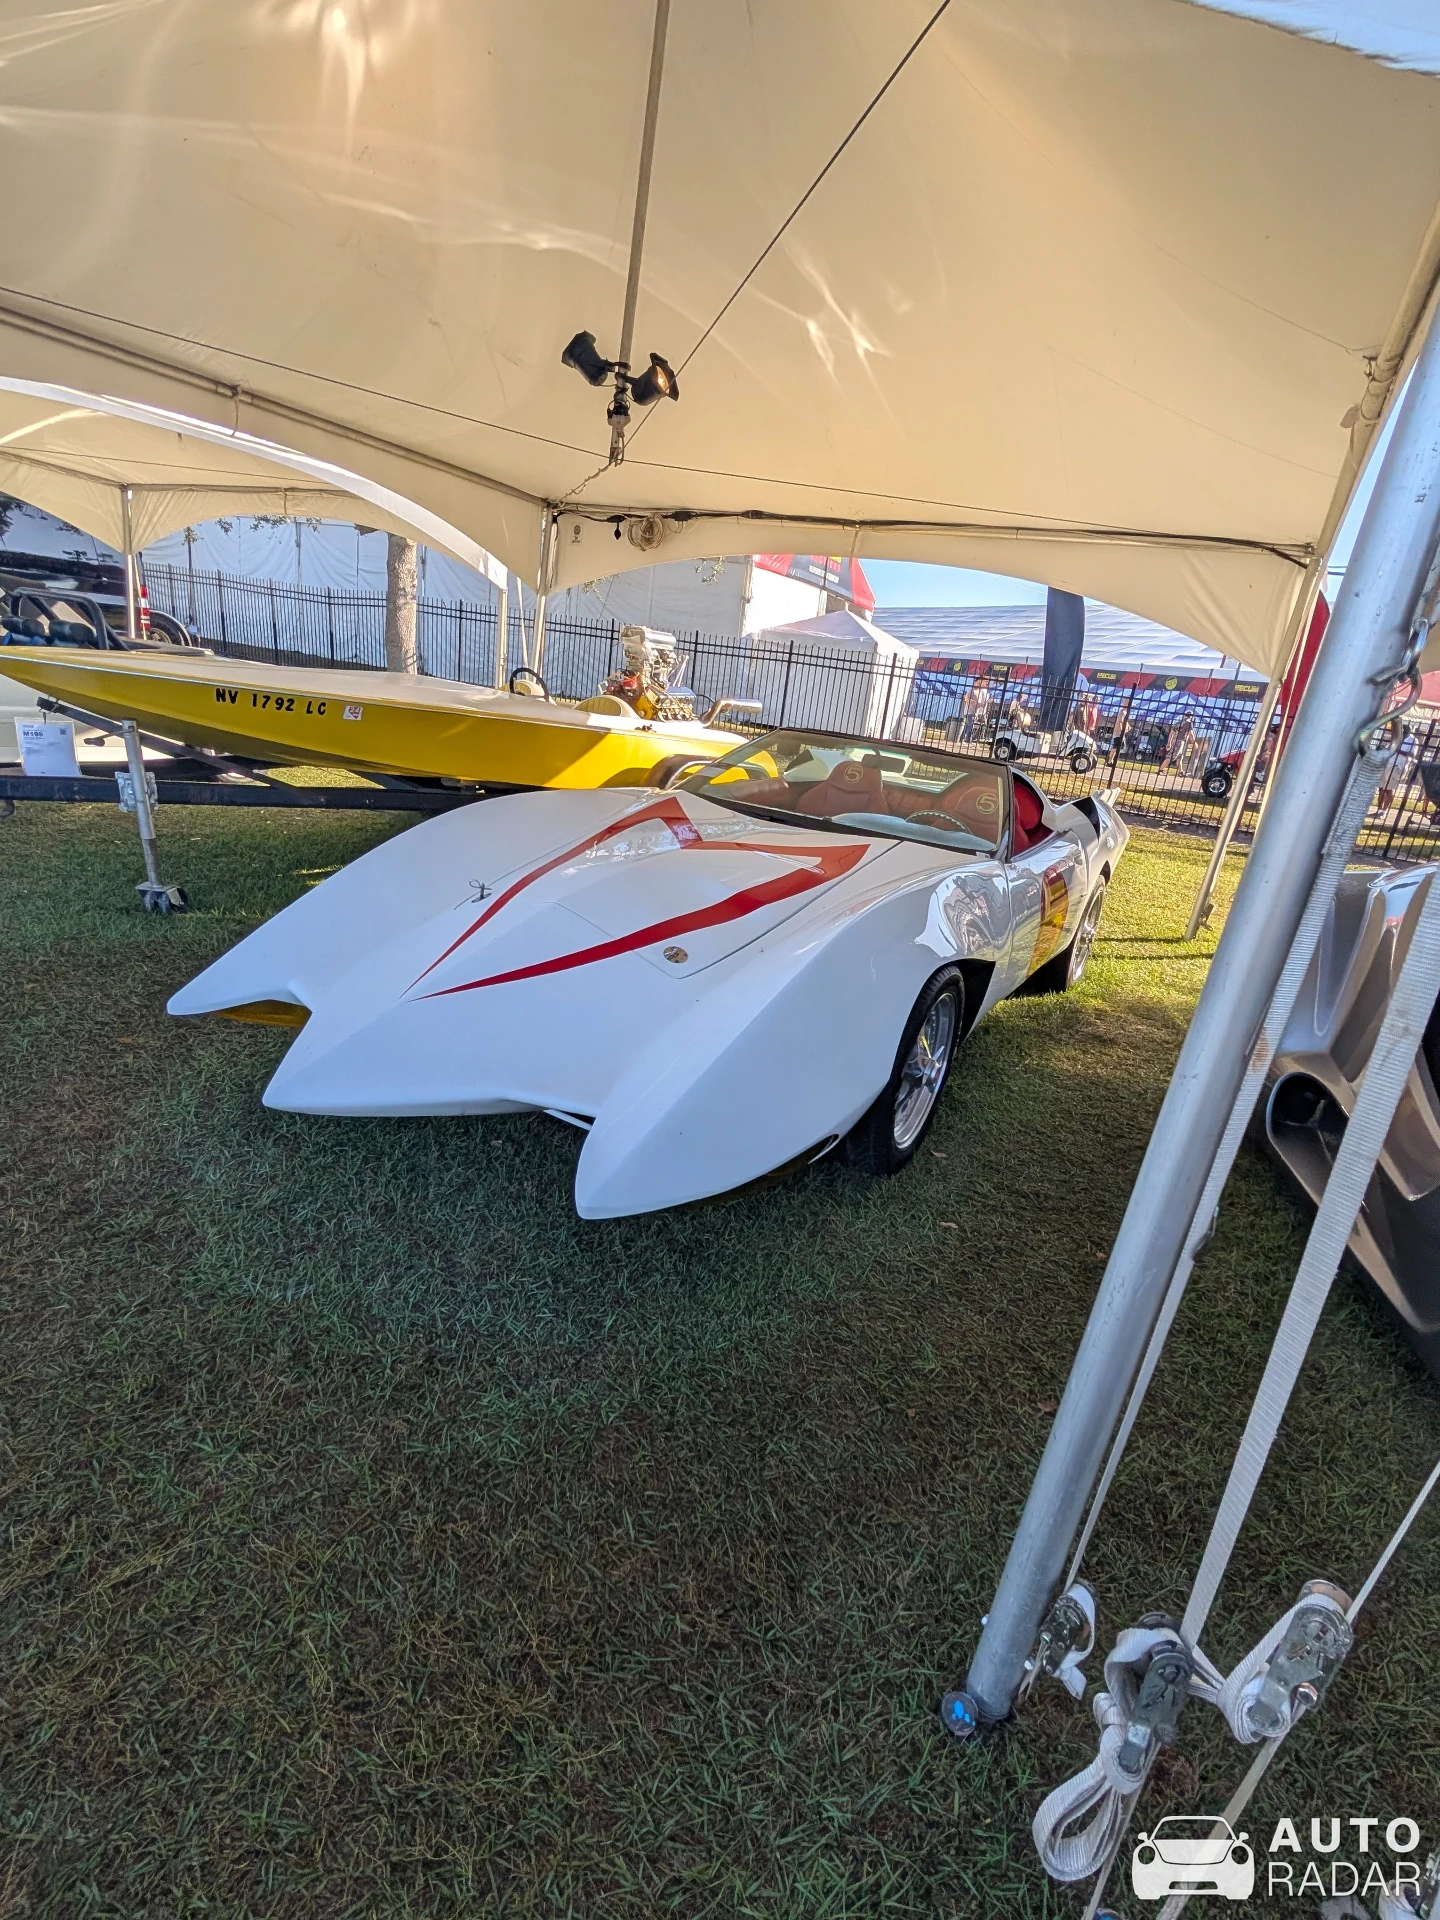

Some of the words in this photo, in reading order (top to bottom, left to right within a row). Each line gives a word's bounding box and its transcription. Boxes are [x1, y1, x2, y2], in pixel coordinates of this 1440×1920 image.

[216, 688, 238, 704] NV
[252, 693, 294, 711] 1792
[306, 701, 326, 715] LC
